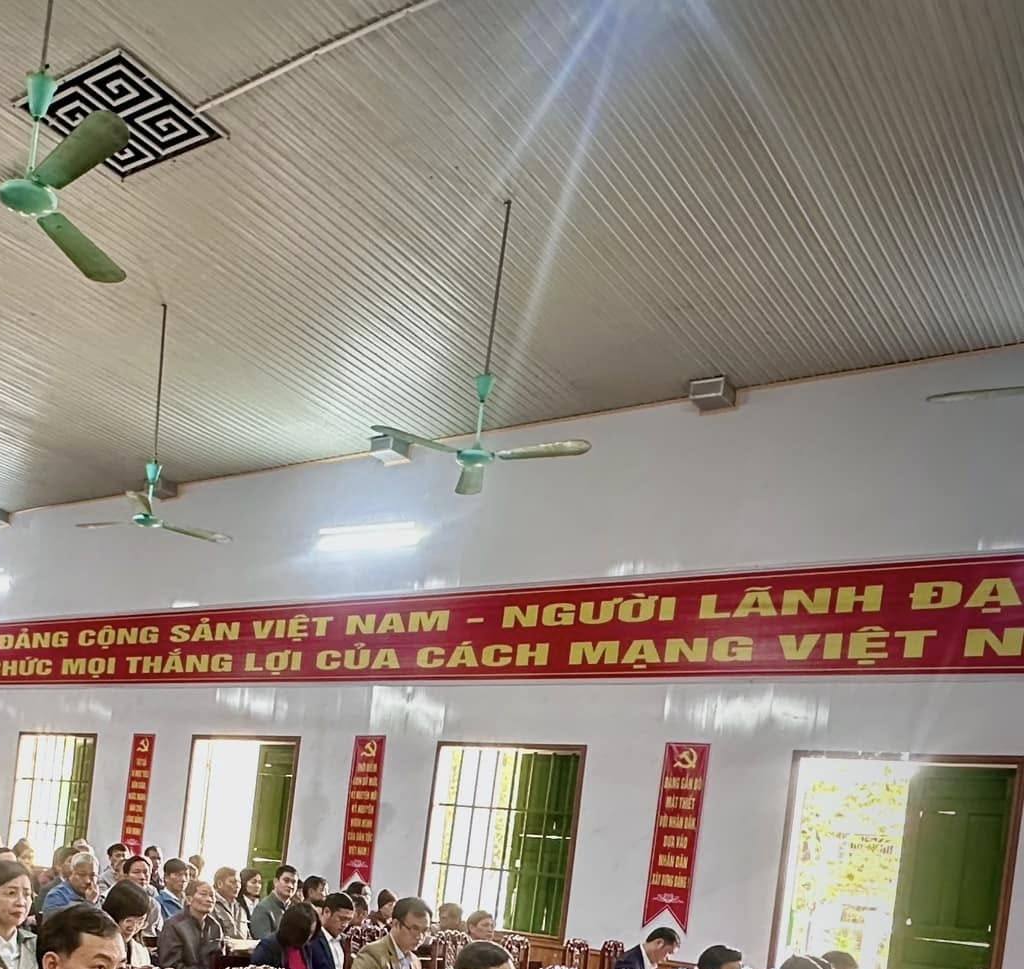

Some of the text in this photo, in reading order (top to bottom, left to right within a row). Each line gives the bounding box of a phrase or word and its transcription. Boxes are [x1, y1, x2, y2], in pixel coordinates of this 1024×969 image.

[78, 627, 160, 651] CỘNG
[170, 617, 241, 643] SẢN
[252, 615, 335, 642] VIỆT
[345, 610, 450, 636] NAM
[501, 593, 677, 629] NGƯỜI
[698, 586, 884, 620] LÃNH
[60, 657, 116, 679] MỌI
[128, 649, 234, 674] THẮNG
[244, 650, 303, 675] LỢI
[315, 643, 401, 671] CỦA
[416, 637, 551, 669] CÁCH
[568, 635, 755, 669] MẠNG
[777, 626, 938, 665] VIỆT
